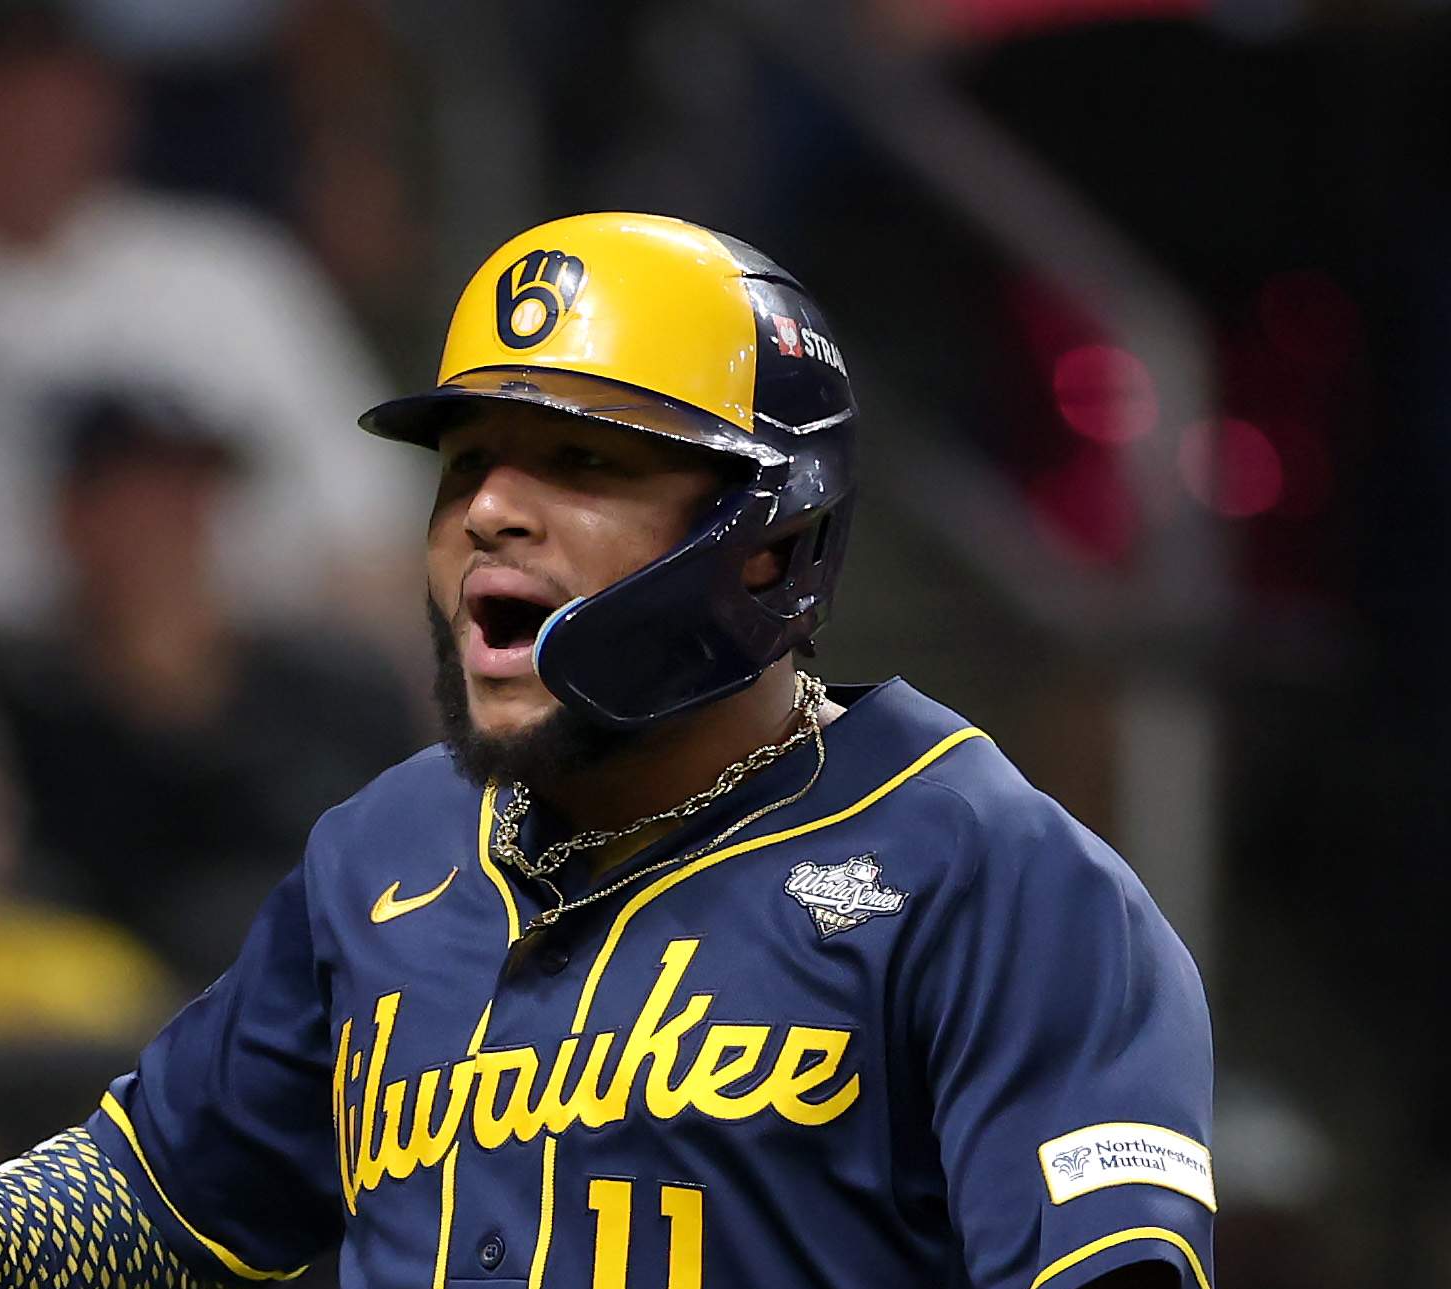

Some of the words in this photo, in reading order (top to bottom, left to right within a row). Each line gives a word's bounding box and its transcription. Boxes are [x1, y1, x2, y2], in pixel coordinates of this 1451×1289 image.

[787, 865, 854, 903] World
[1095, 1138, 1208, 1177] Northwestern
[1100, 1154, 1167, 1172] Mutual
